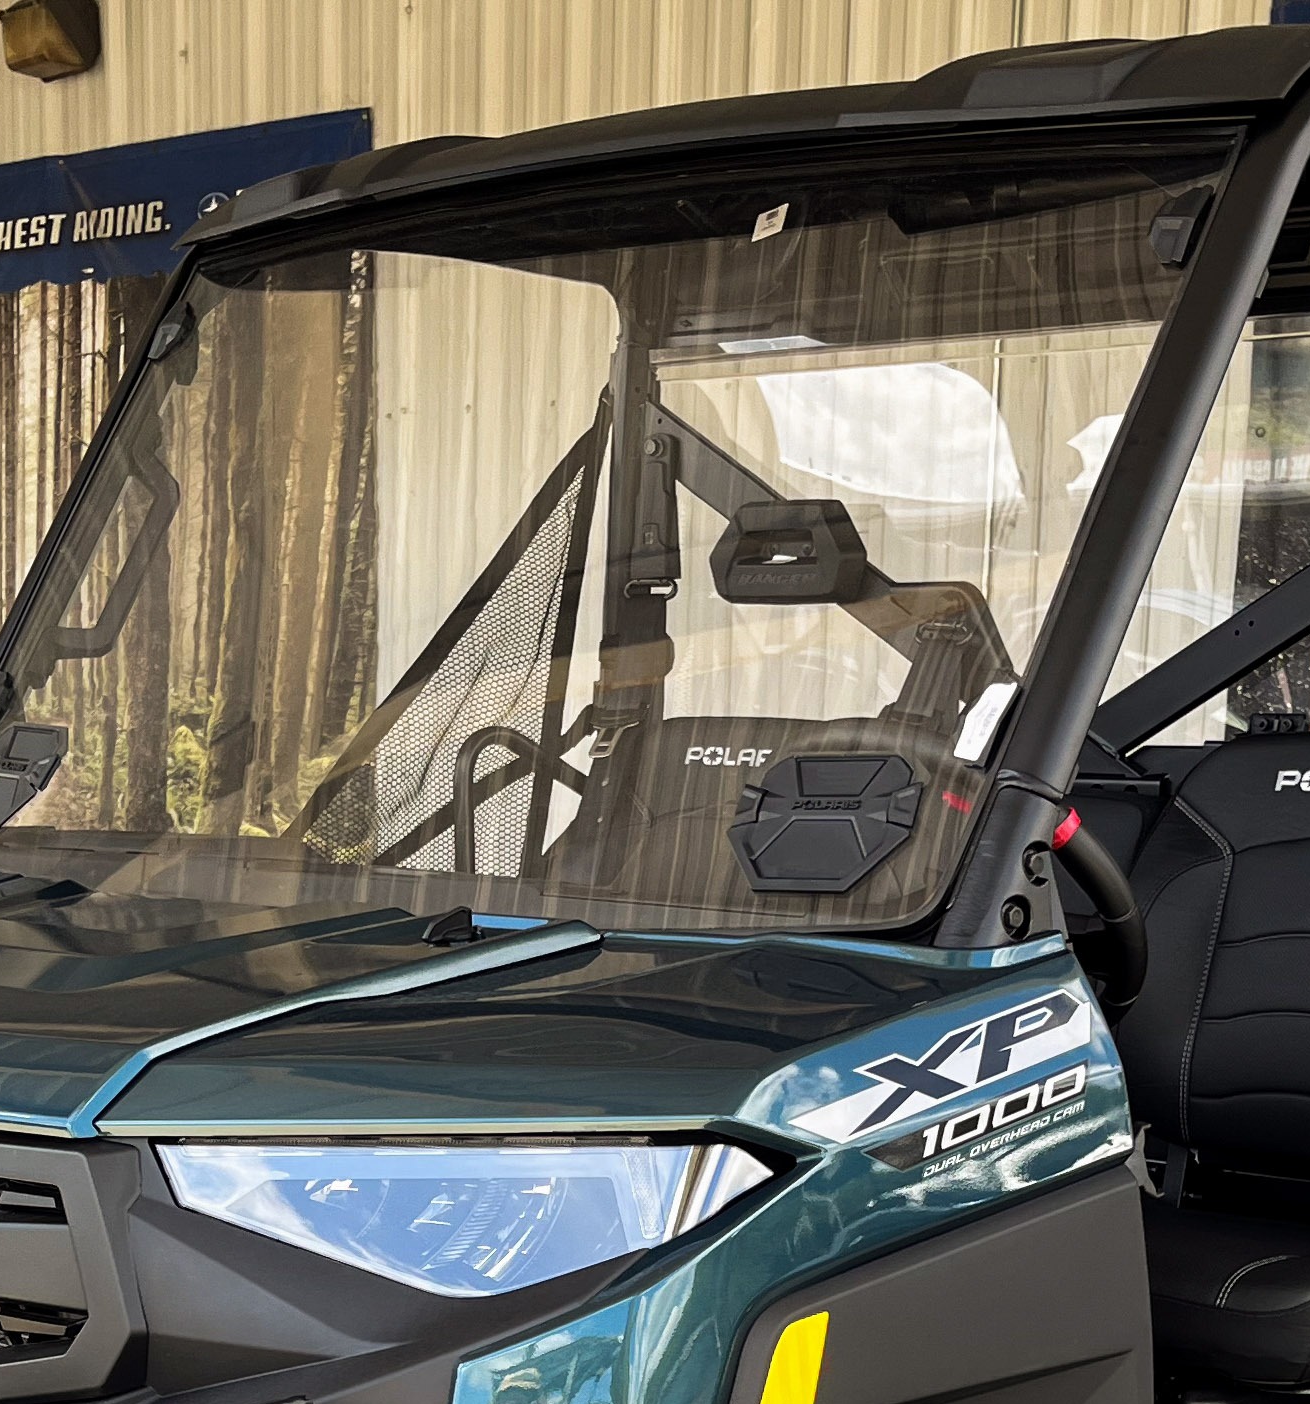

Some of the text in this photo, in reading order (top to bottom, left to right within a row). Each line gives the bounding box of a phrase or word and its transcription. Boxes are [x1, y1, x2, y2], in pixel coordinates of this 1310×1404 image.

[790, 799, 863, 811] POLARIS
[846, 989, 1083, 1137] XP
[921, 1063, 1087, 1159] 1000
[923, 1100, 1086, 1178] DUAL OVERHEAD CAM
